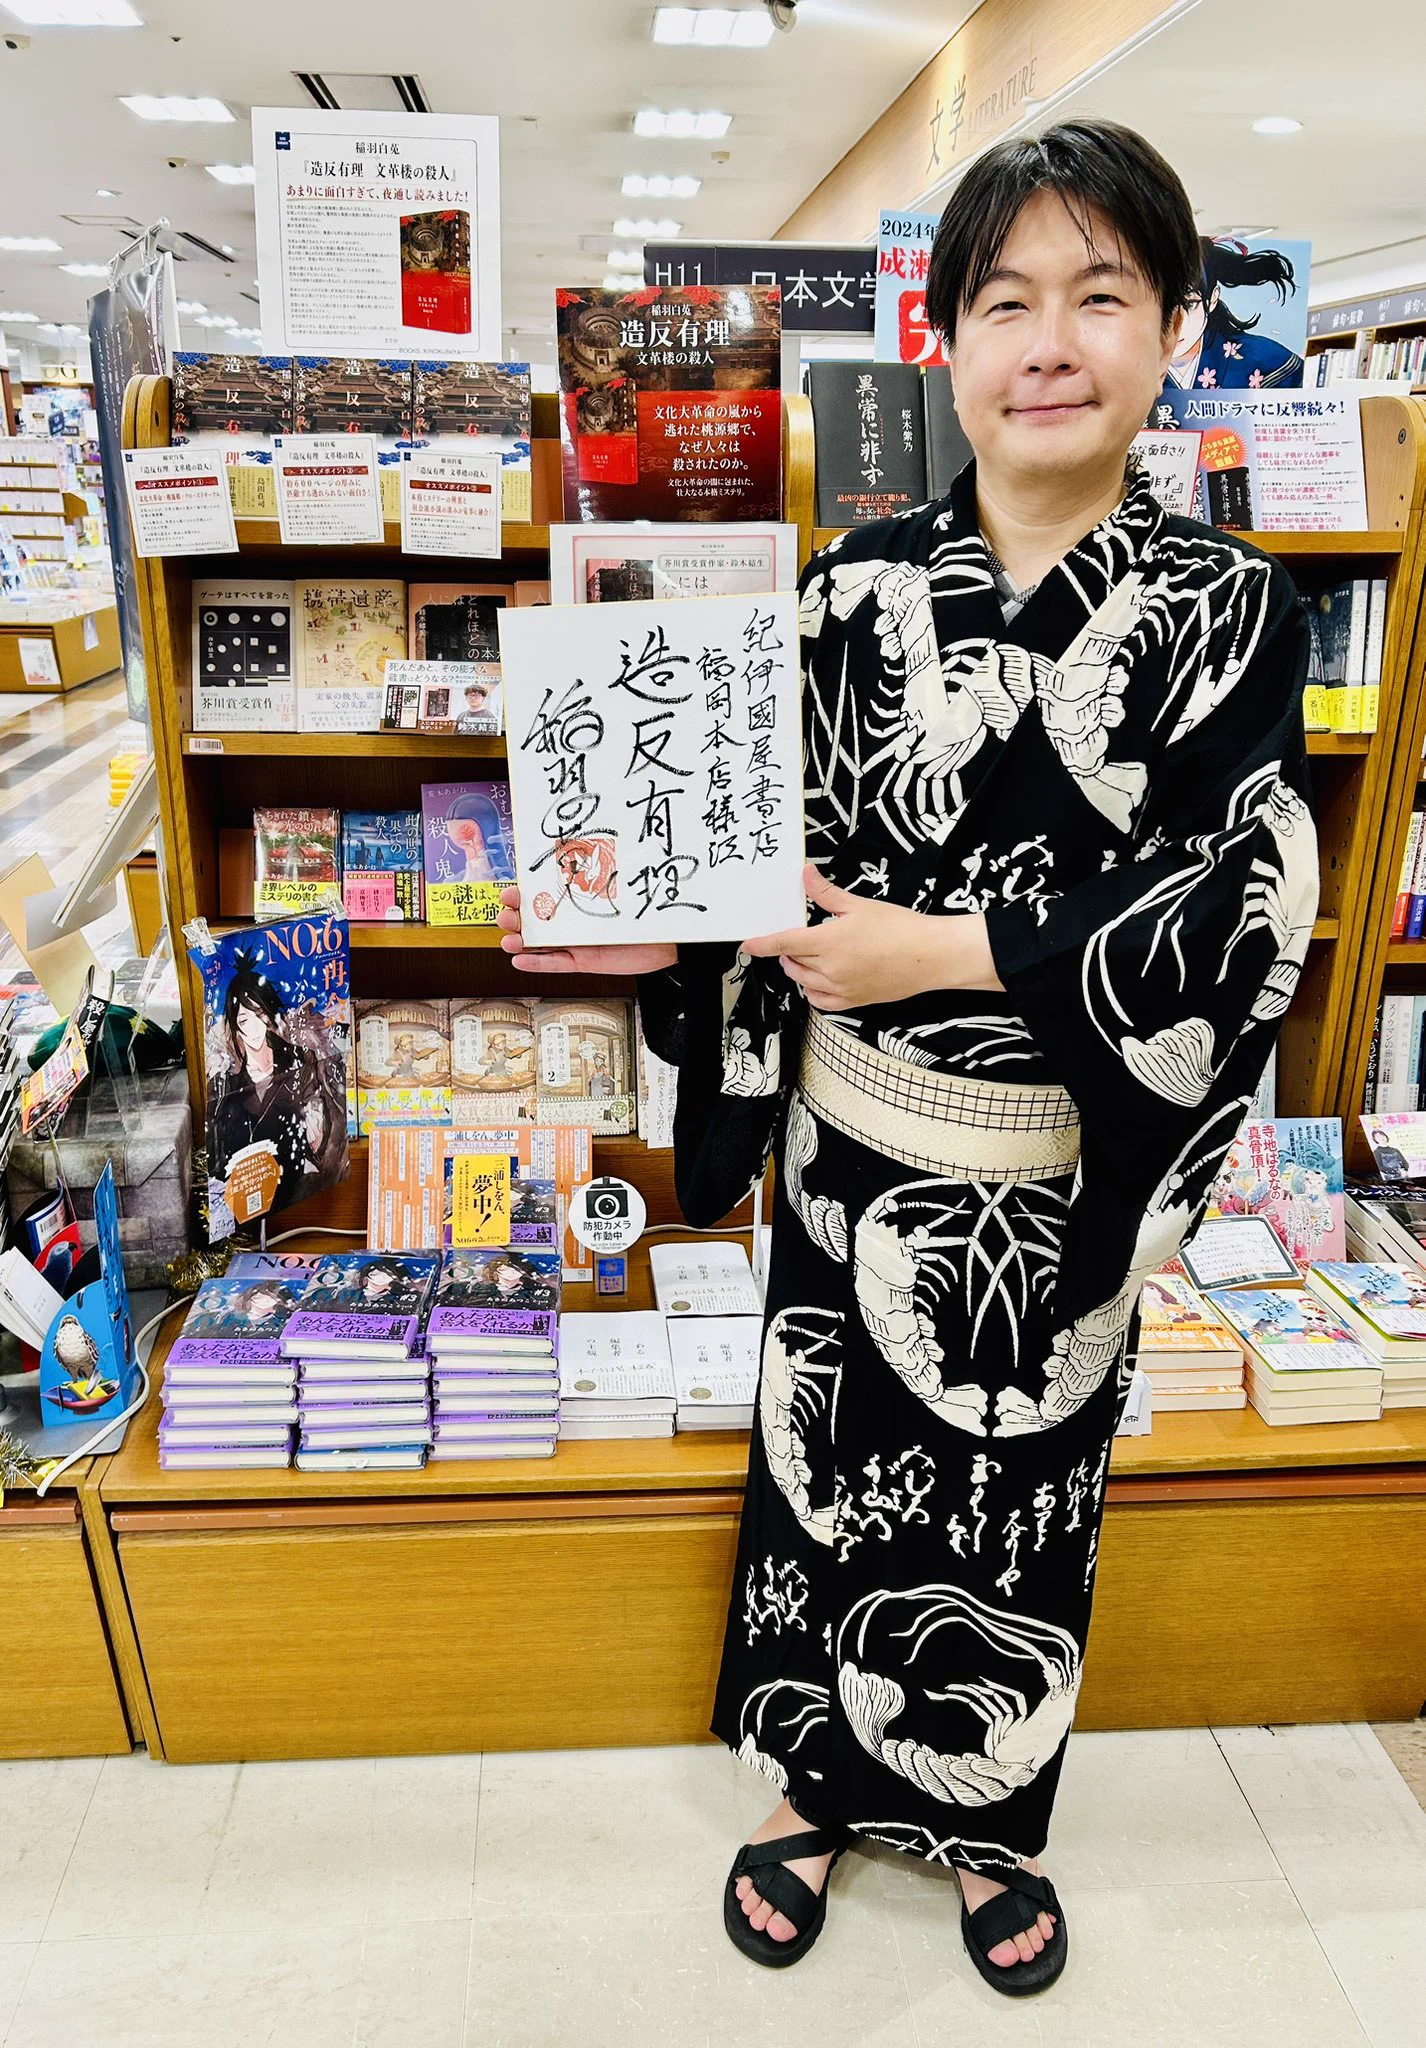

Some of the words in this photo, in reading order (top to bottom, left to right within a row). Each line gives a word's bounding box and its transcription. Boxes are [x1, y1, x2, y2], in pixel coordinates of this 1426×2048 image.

[926, 74, 966, 175] 文学
[304, 160, 363, 176] 『造反有理
[619, 319, 730, 348] 造反有理
[636, 352, 714, 366] 文革楼の殺人
[654, 405, 762, 420] 文化大革命の嵐から
[1186, 400, 1345, 418] 人間ドラマに反響続々!
[664, 423, 756, 436] 逃れた桃源郷で、
[855, 374, 884, 488] 異常に非ず
[901, 408, 913, 453] 桜木紫乃
[679, 440, 740, 452] なぜ人々は
[1204, 444, 1240, 460] メディアで
[672, 458, 749, 471] 殺されたのか。
[200, 591, 289, 600] ゲーテはすべてを言った
[608, 625, 707, 919] 造反有理
[376, 816, 387, 840] 殺人
[390, 820, 402, 854] 果ての
[405, 815, 419, 860] 此の世の
[428, 817, 458, 880] 殺人鬼
[262, 883, 317, 892] 世界レベルの
[265, 914, 344, 965] NO.6
[1247, 1125, 1265, 1183] 真骨頂!
[1262, 1124, 1281, 1201] 寺地はるなの
[494, 1160, 505, 1214] 三浦しをん、
[472, 1175, 493, 1233] 夢中!
[583, 1221, 631, 1231] 防犯カメラ
[593, 1232, 623, 1240] 作動中
